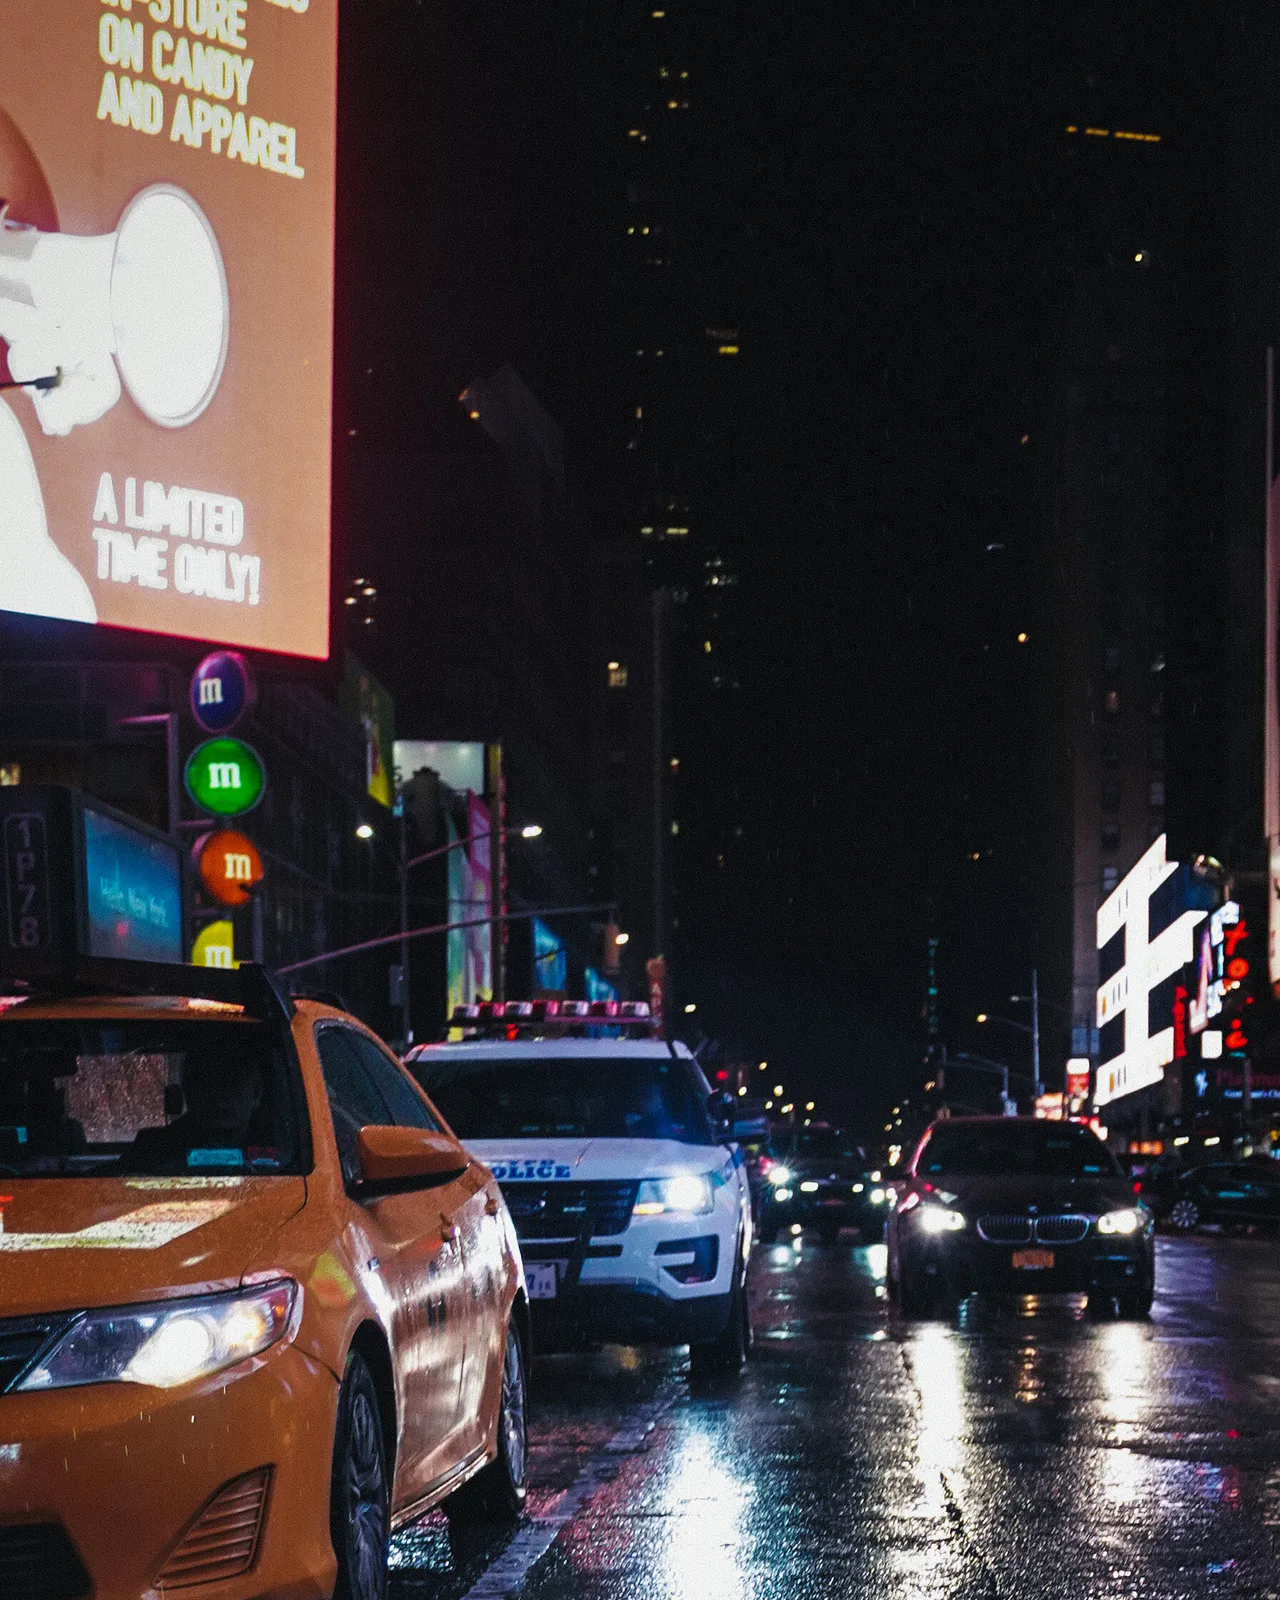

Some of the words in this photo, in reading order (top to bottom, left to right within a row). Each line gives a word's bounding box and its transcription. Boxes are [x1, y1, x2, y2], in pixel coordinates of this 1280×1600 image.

[99, 12, 143, 72] ON
[152, 30, 254, 105] CANDY
[96, 71, 163, 135] AND
[170, 93, 305, 179] APPAREL
[93, 472, 118, 524] A
[125, 477, 244, 547] LIMITED
[92, 527, 168, 590] TIME
[174, 543, 261, 605] ONLY!
[199, 678, 224, 704] m
[208, 762, 241, 788] m
[224, 853, 251, 880] m
[491, 1164, 571, 1180] OLICE
